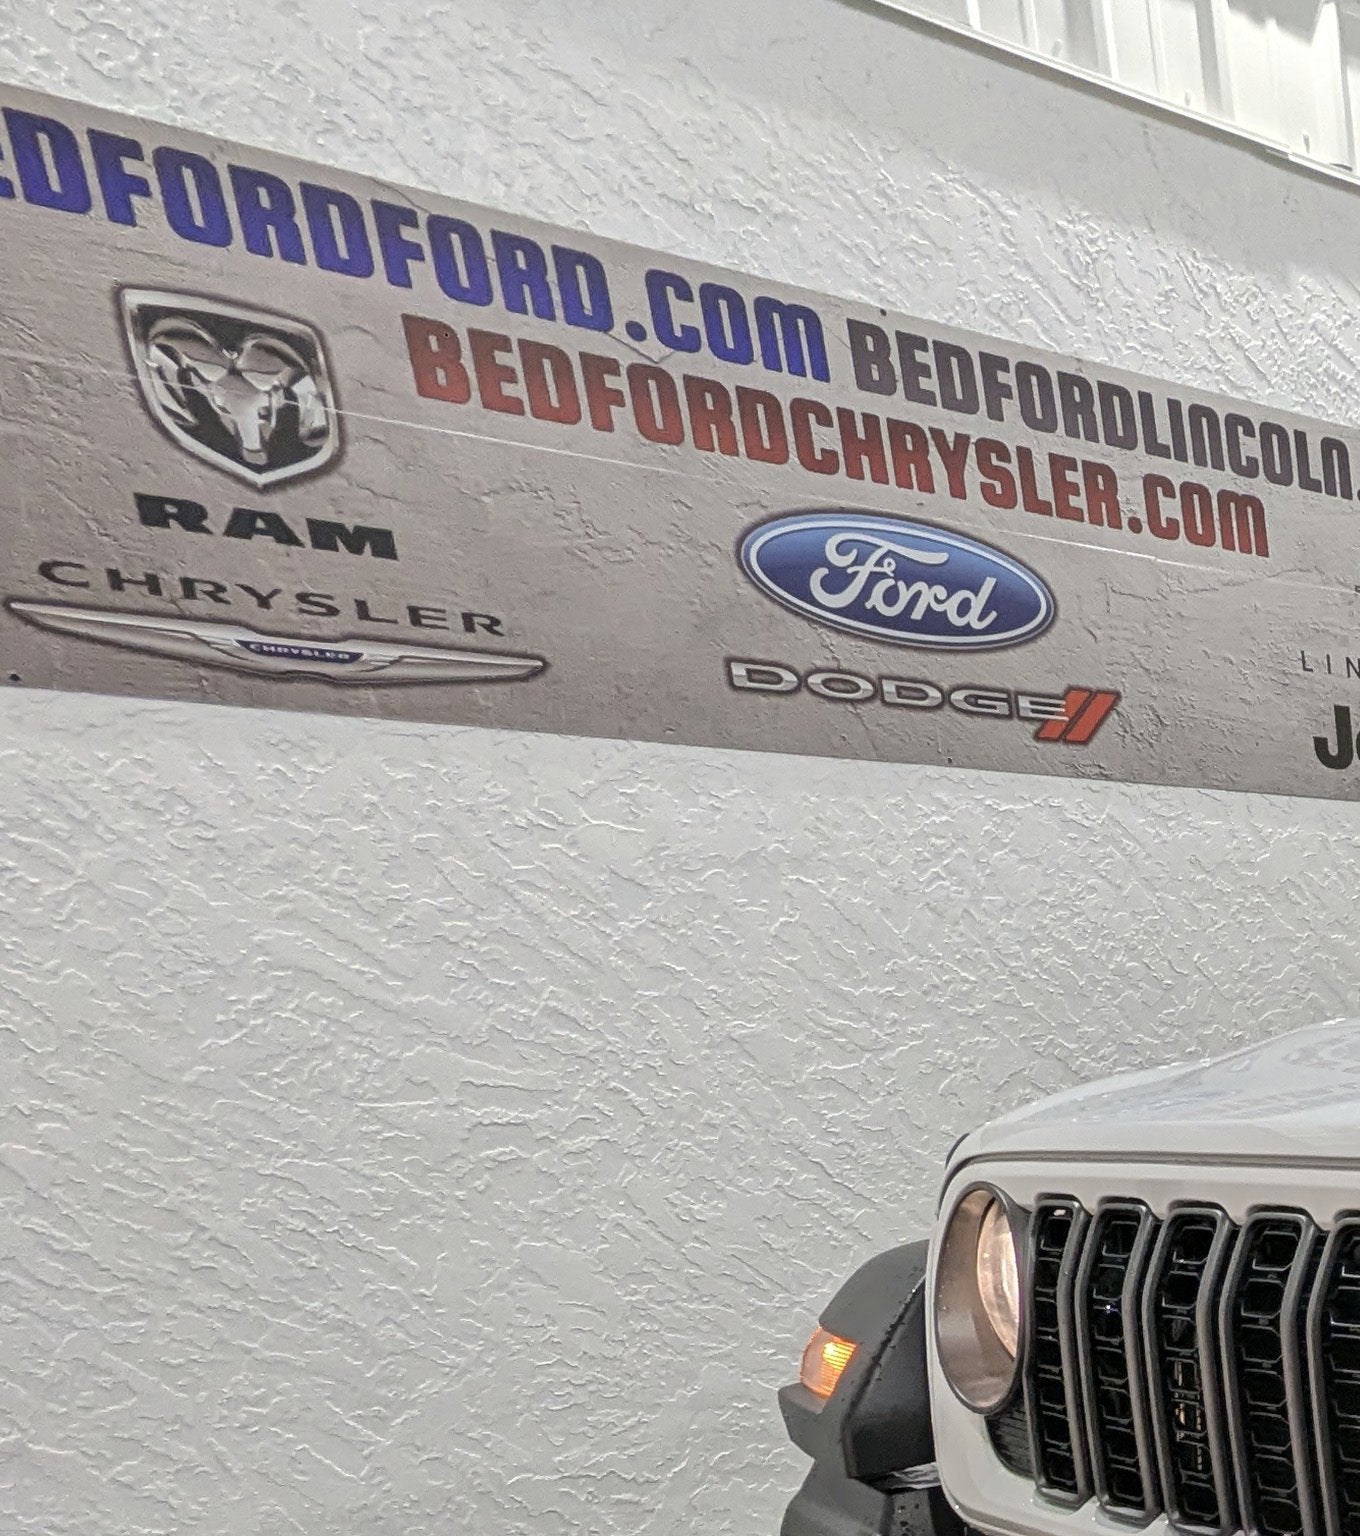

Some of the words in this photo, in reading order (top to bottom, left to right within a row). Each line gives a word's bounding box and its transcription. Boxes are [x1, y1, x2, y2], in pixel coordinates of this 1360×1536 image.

[0, 107, 829, 383] DFORDFORD.COM
[400, 313, 1270, 558] BEDFORDCHRYSLER.COM
[133, 492, 398, 560] RAM
[37, 560, 504, 636] CHRYSLER
[809, 531, 997, 632] Ford
[730, 658, 1069, 722] DODGE
